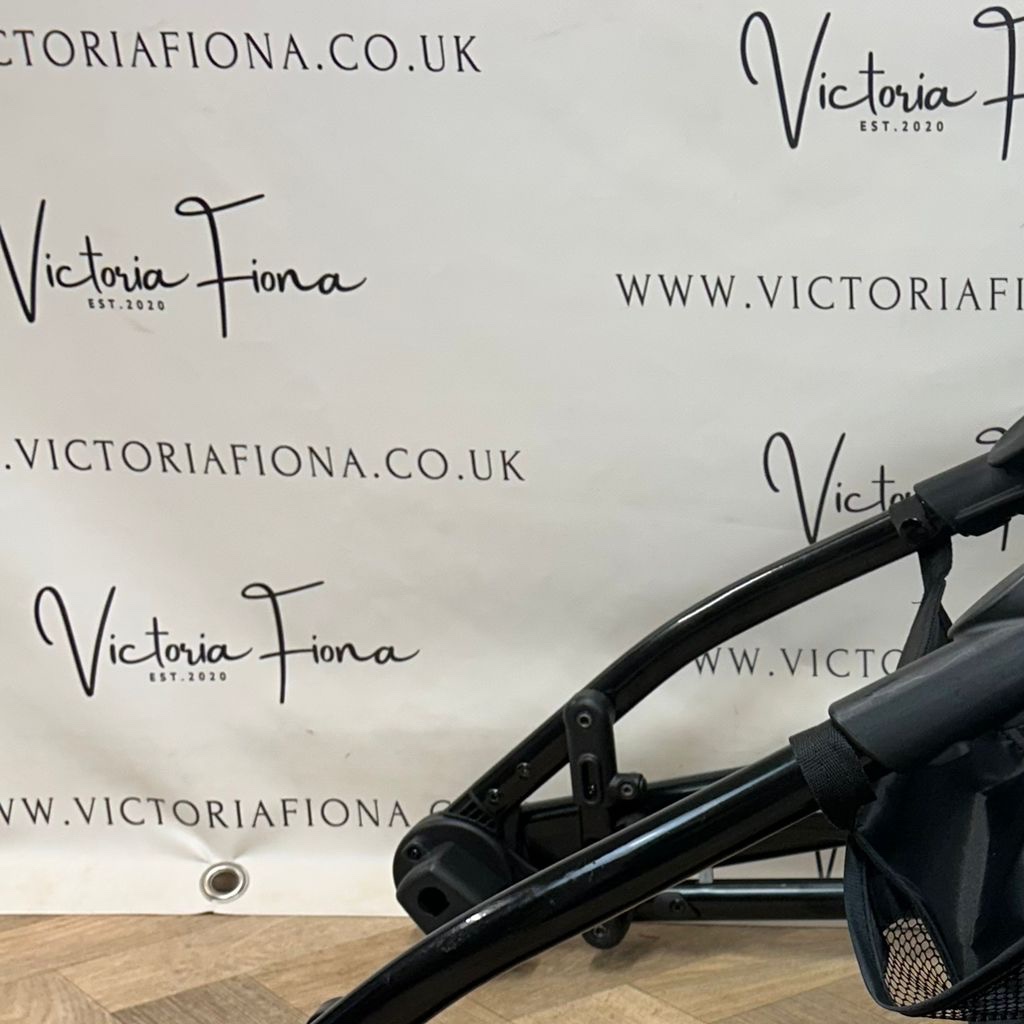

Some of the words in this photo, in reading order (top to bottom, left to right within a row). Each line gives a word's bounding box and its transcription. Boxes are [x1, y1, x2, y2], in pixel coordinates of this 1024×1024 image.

[740, 11, 977, 149] Victoria
[860, 121, 943, 132] EST.2020
[175, 194, 367, 338] Fiona
[88, 298, 164, 311] EST.2020
[5, 438, 525, 481] .VICTORIAFIONA.CO.UK
[34, 586, 252, 697] Victoria
[241, 581, 420, 704] Fiona
[150, 672, 226, 682] EST.2020
